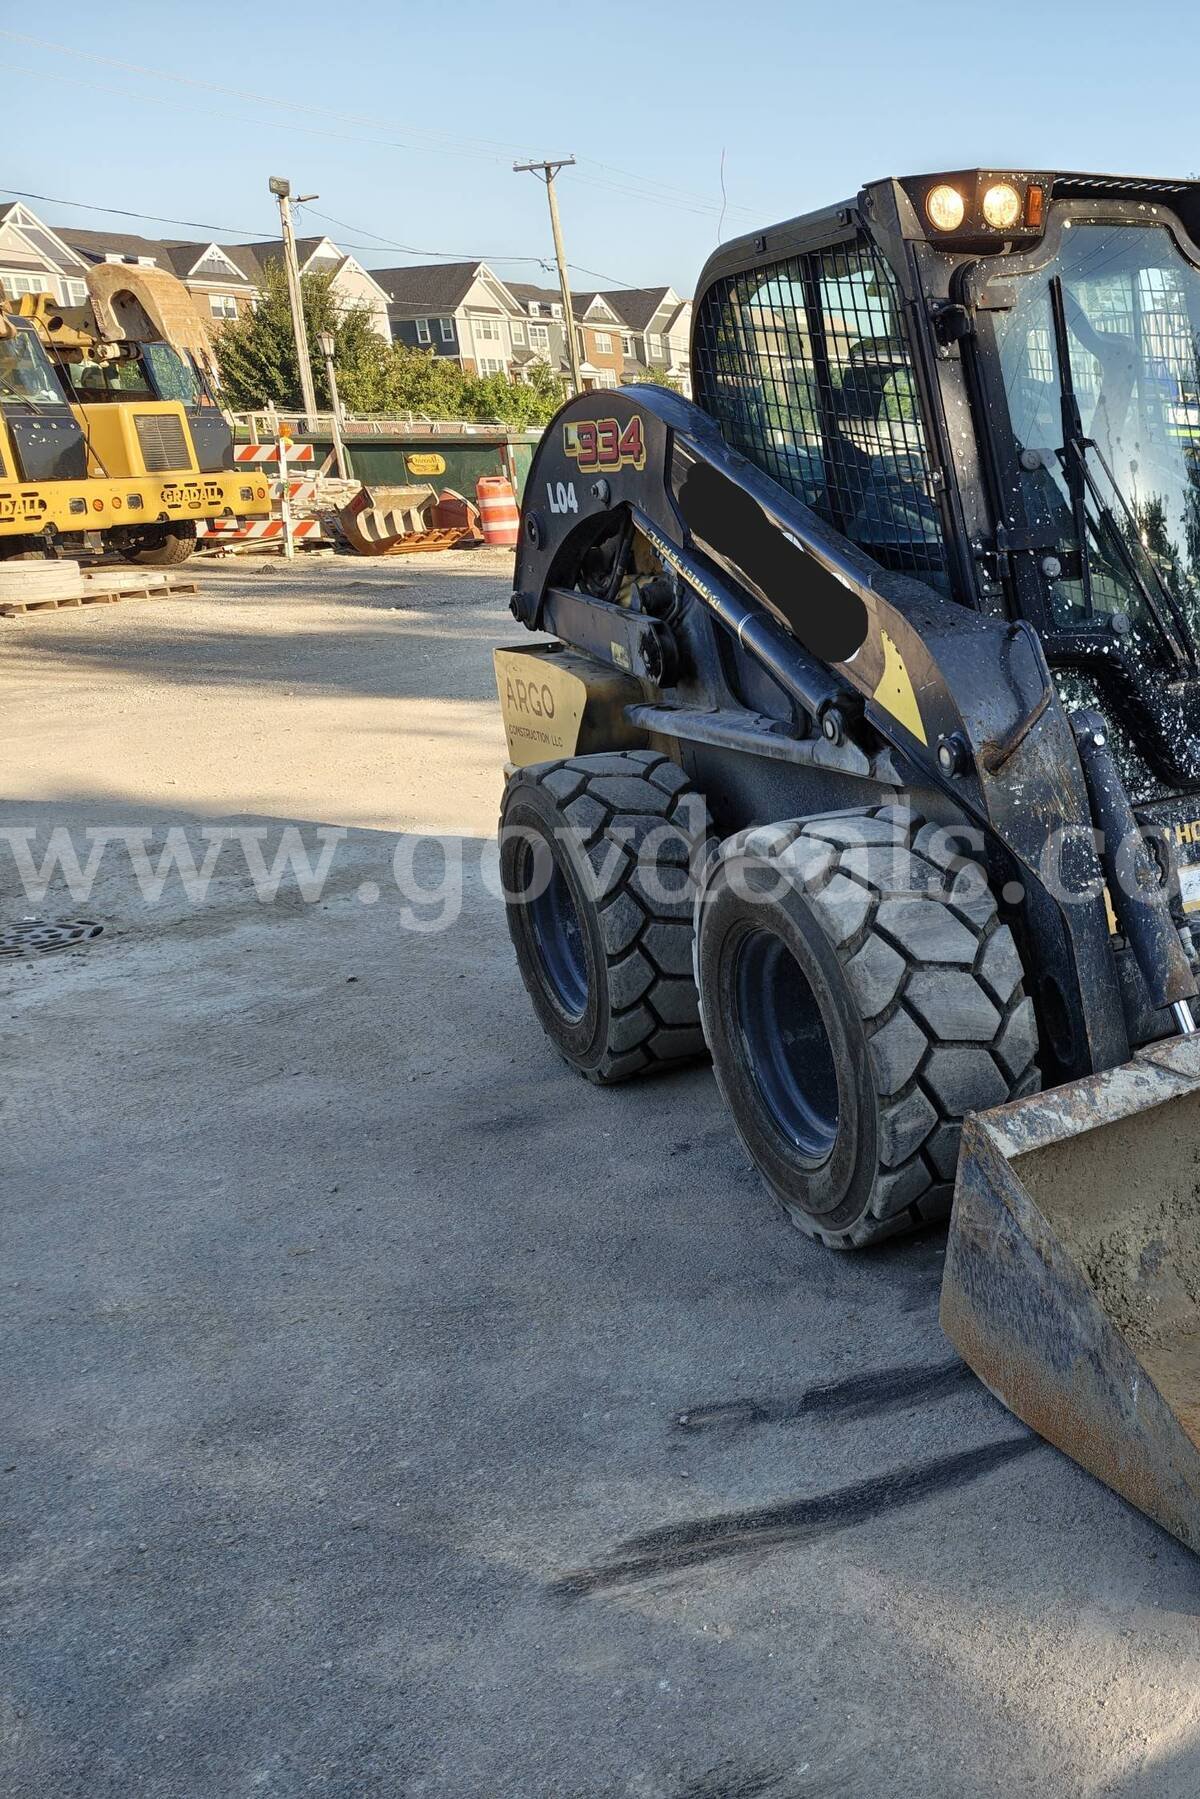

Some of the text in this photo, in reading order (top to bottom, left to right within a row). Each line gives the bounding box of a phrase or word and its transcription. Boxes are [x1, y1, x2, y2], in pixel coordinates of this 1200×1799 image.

[163, 487, 222, 502] GRADALL
[546, 481, 579, 514] L04
[507, 676, 556, 720] ARGO
[508, 723, 564, 748] CONSTRUCTION LLC
